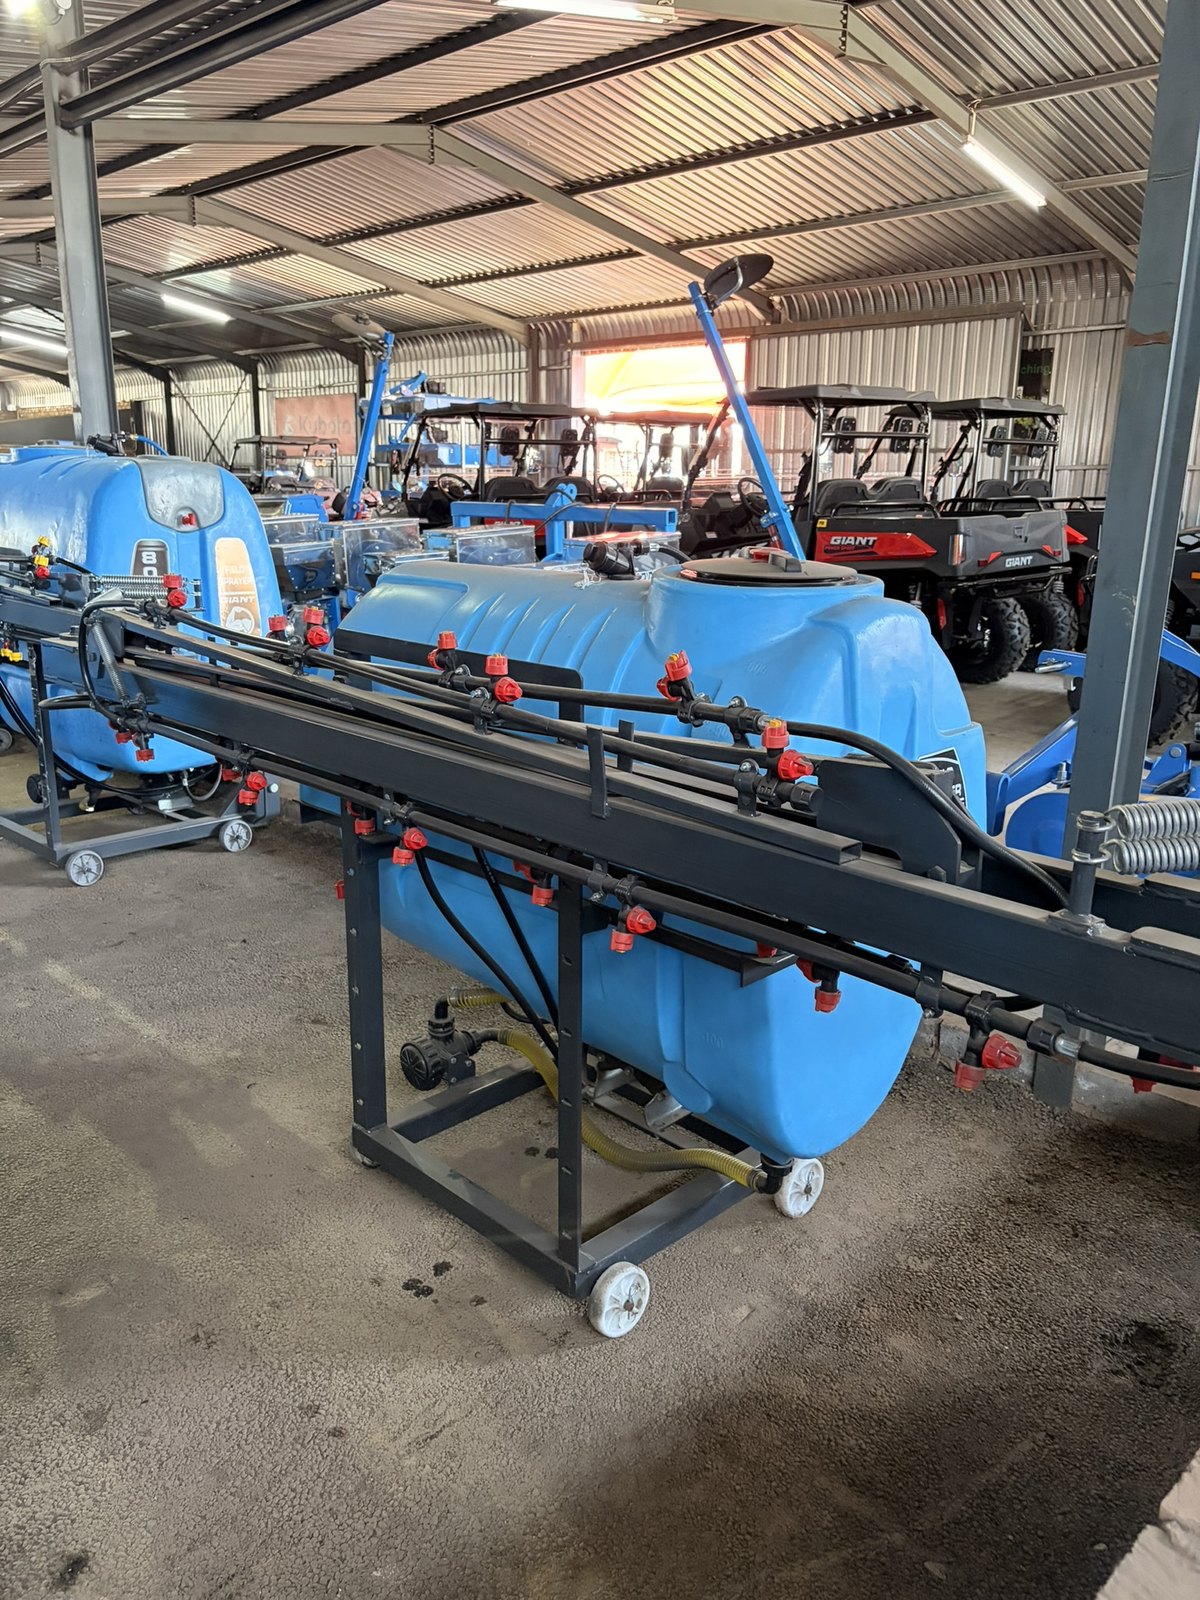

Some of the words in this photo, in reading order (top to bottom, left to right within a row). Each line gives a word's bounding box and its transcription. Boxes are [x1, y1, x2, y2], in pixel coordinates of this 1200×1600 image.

[829, 536, 878, 546] GIANT
[1005, 556, 1034, 568] GIANT
[220, 595, 255, 604] GIANT
